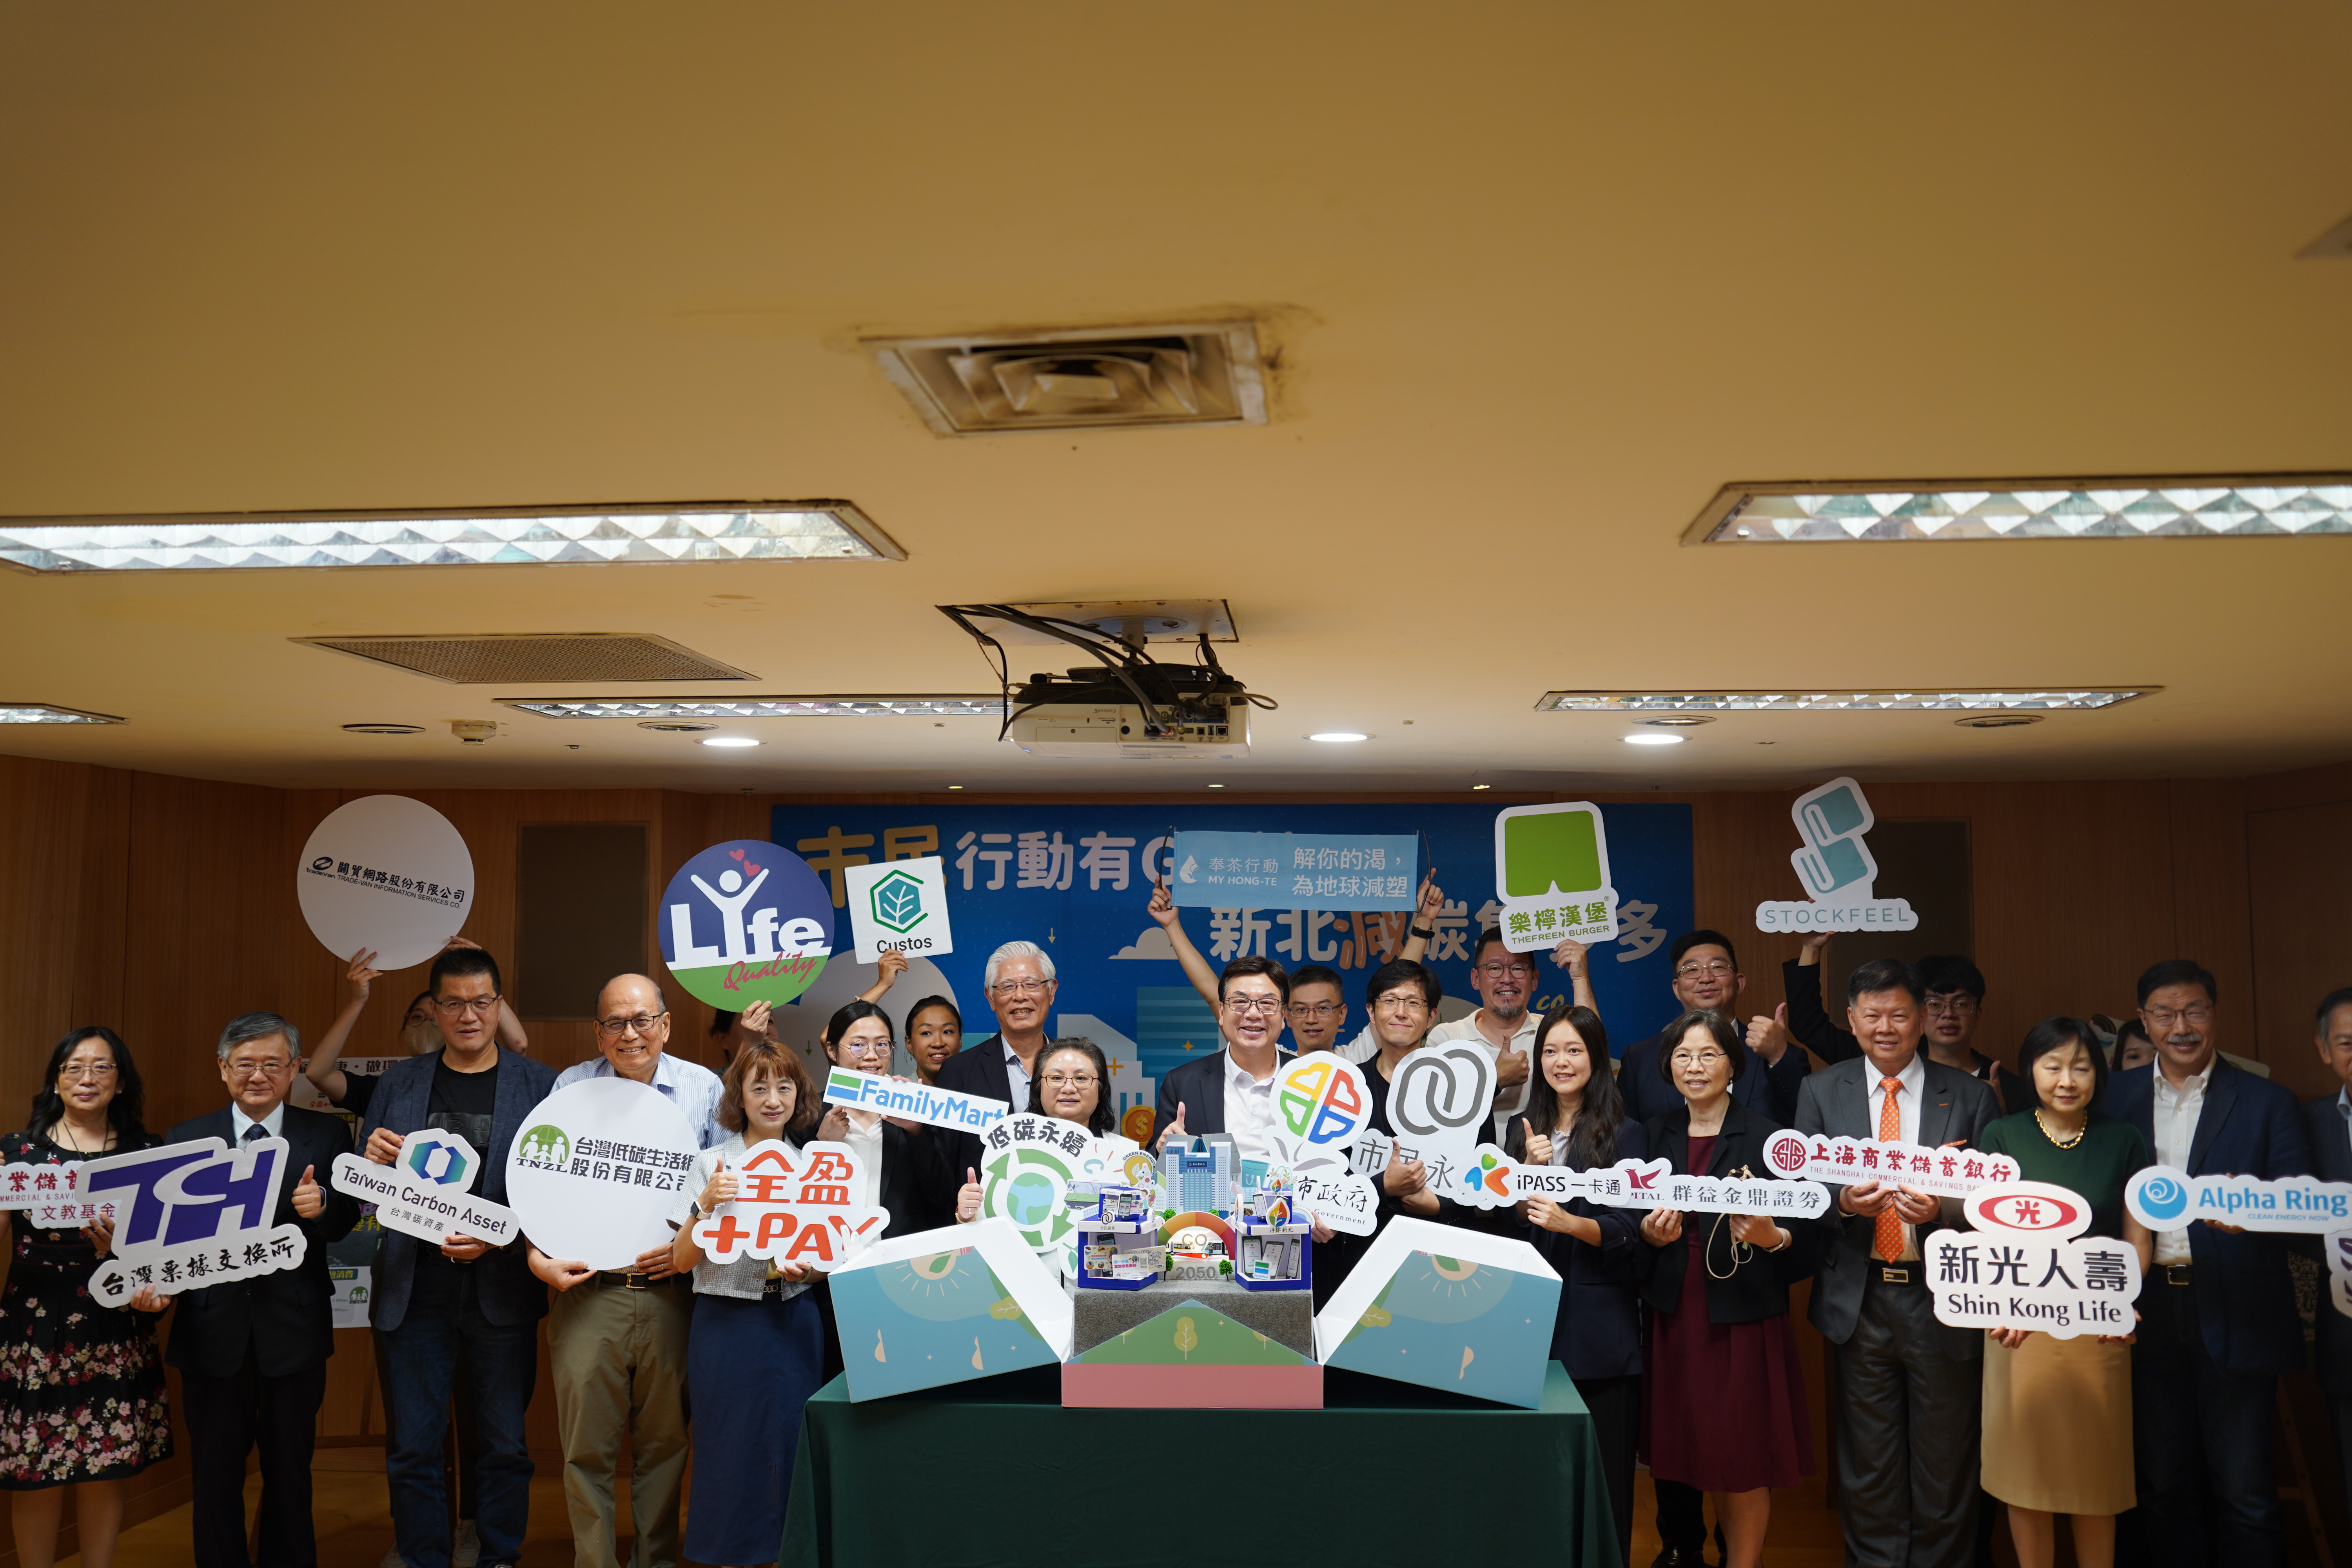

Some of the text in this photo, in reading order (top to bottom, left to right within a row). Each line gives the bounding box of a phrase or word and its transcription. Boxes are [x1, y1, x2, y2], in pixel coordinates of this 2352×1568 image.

[306, 867, 335, 879] tradevan
[1208, 857, 1278, 874] 奉茶行動
[337, 862, 465, 902] 關貿網路股份有限公司
[338, 874, 373, 888] TRADE-VAN
[374, 883, 416, 898] INFORMATION
[417, 894, 448, 906] SERVICES
[1209, 876, 1277, 886] MY HONG-TE
[1292, 875, 1408, 898] 為地球減塑
[1509, 902, 1608, 935] 樂檸漢堡
[1765, 907, 1909, 924] STOCKFEEL
[877, 936, 932, 953] Custos
[1511, 925, 1610, 945] THEFREEN BURGER
[723, 950, 818, 992] Quality
[860, 1079, 1005, 1127] FamilyMart
[987, 1118, 1087, 1158] 低碳永續
[516, 1158, 568, 1173] TNZL
[1123, 1151, 1156, 1166] GREEN ENERGY
[1811, 1143, 2011, 1183] 上海商業儲蓄銀行
[735, 1150, 853, 1205] 全盈
[1518, 1174, 1621, 1195] iPASS 一卡通
[1827, 1168, 1864, 1179] SHANGHAI
[1869, 1173, 1917, 1185] COMMERCIAL
[1929, 1179, 1964, 1190] SAVINGS
[344, 1165, 507, 1234] Taiwan Carbon Asset
[1298, 1176, 1367, 1212] 市政府
[1672, 1183, 1821, 1209] 群益金鼎證券
[2199, 1187, 2348, 1218] Alpha Ring
[41, 1203, 115, 1221] 文教基金
[390, 1207, 445, 1232] 台灣碳資產
[1314, 1209, 1366, 1225] Government
[2015, 1200, 2041, 1225] 光
[703, 1213, 879, 1261] +PAY
[102, 1236, 295, 1296] 台灣票據交換所
[1176, 1266, 1216, 1279] 2050
[1939, 1243, 2127, 1292] 新光人壽
[1949, 1293, 2122, 1326] Shin Kong Life
